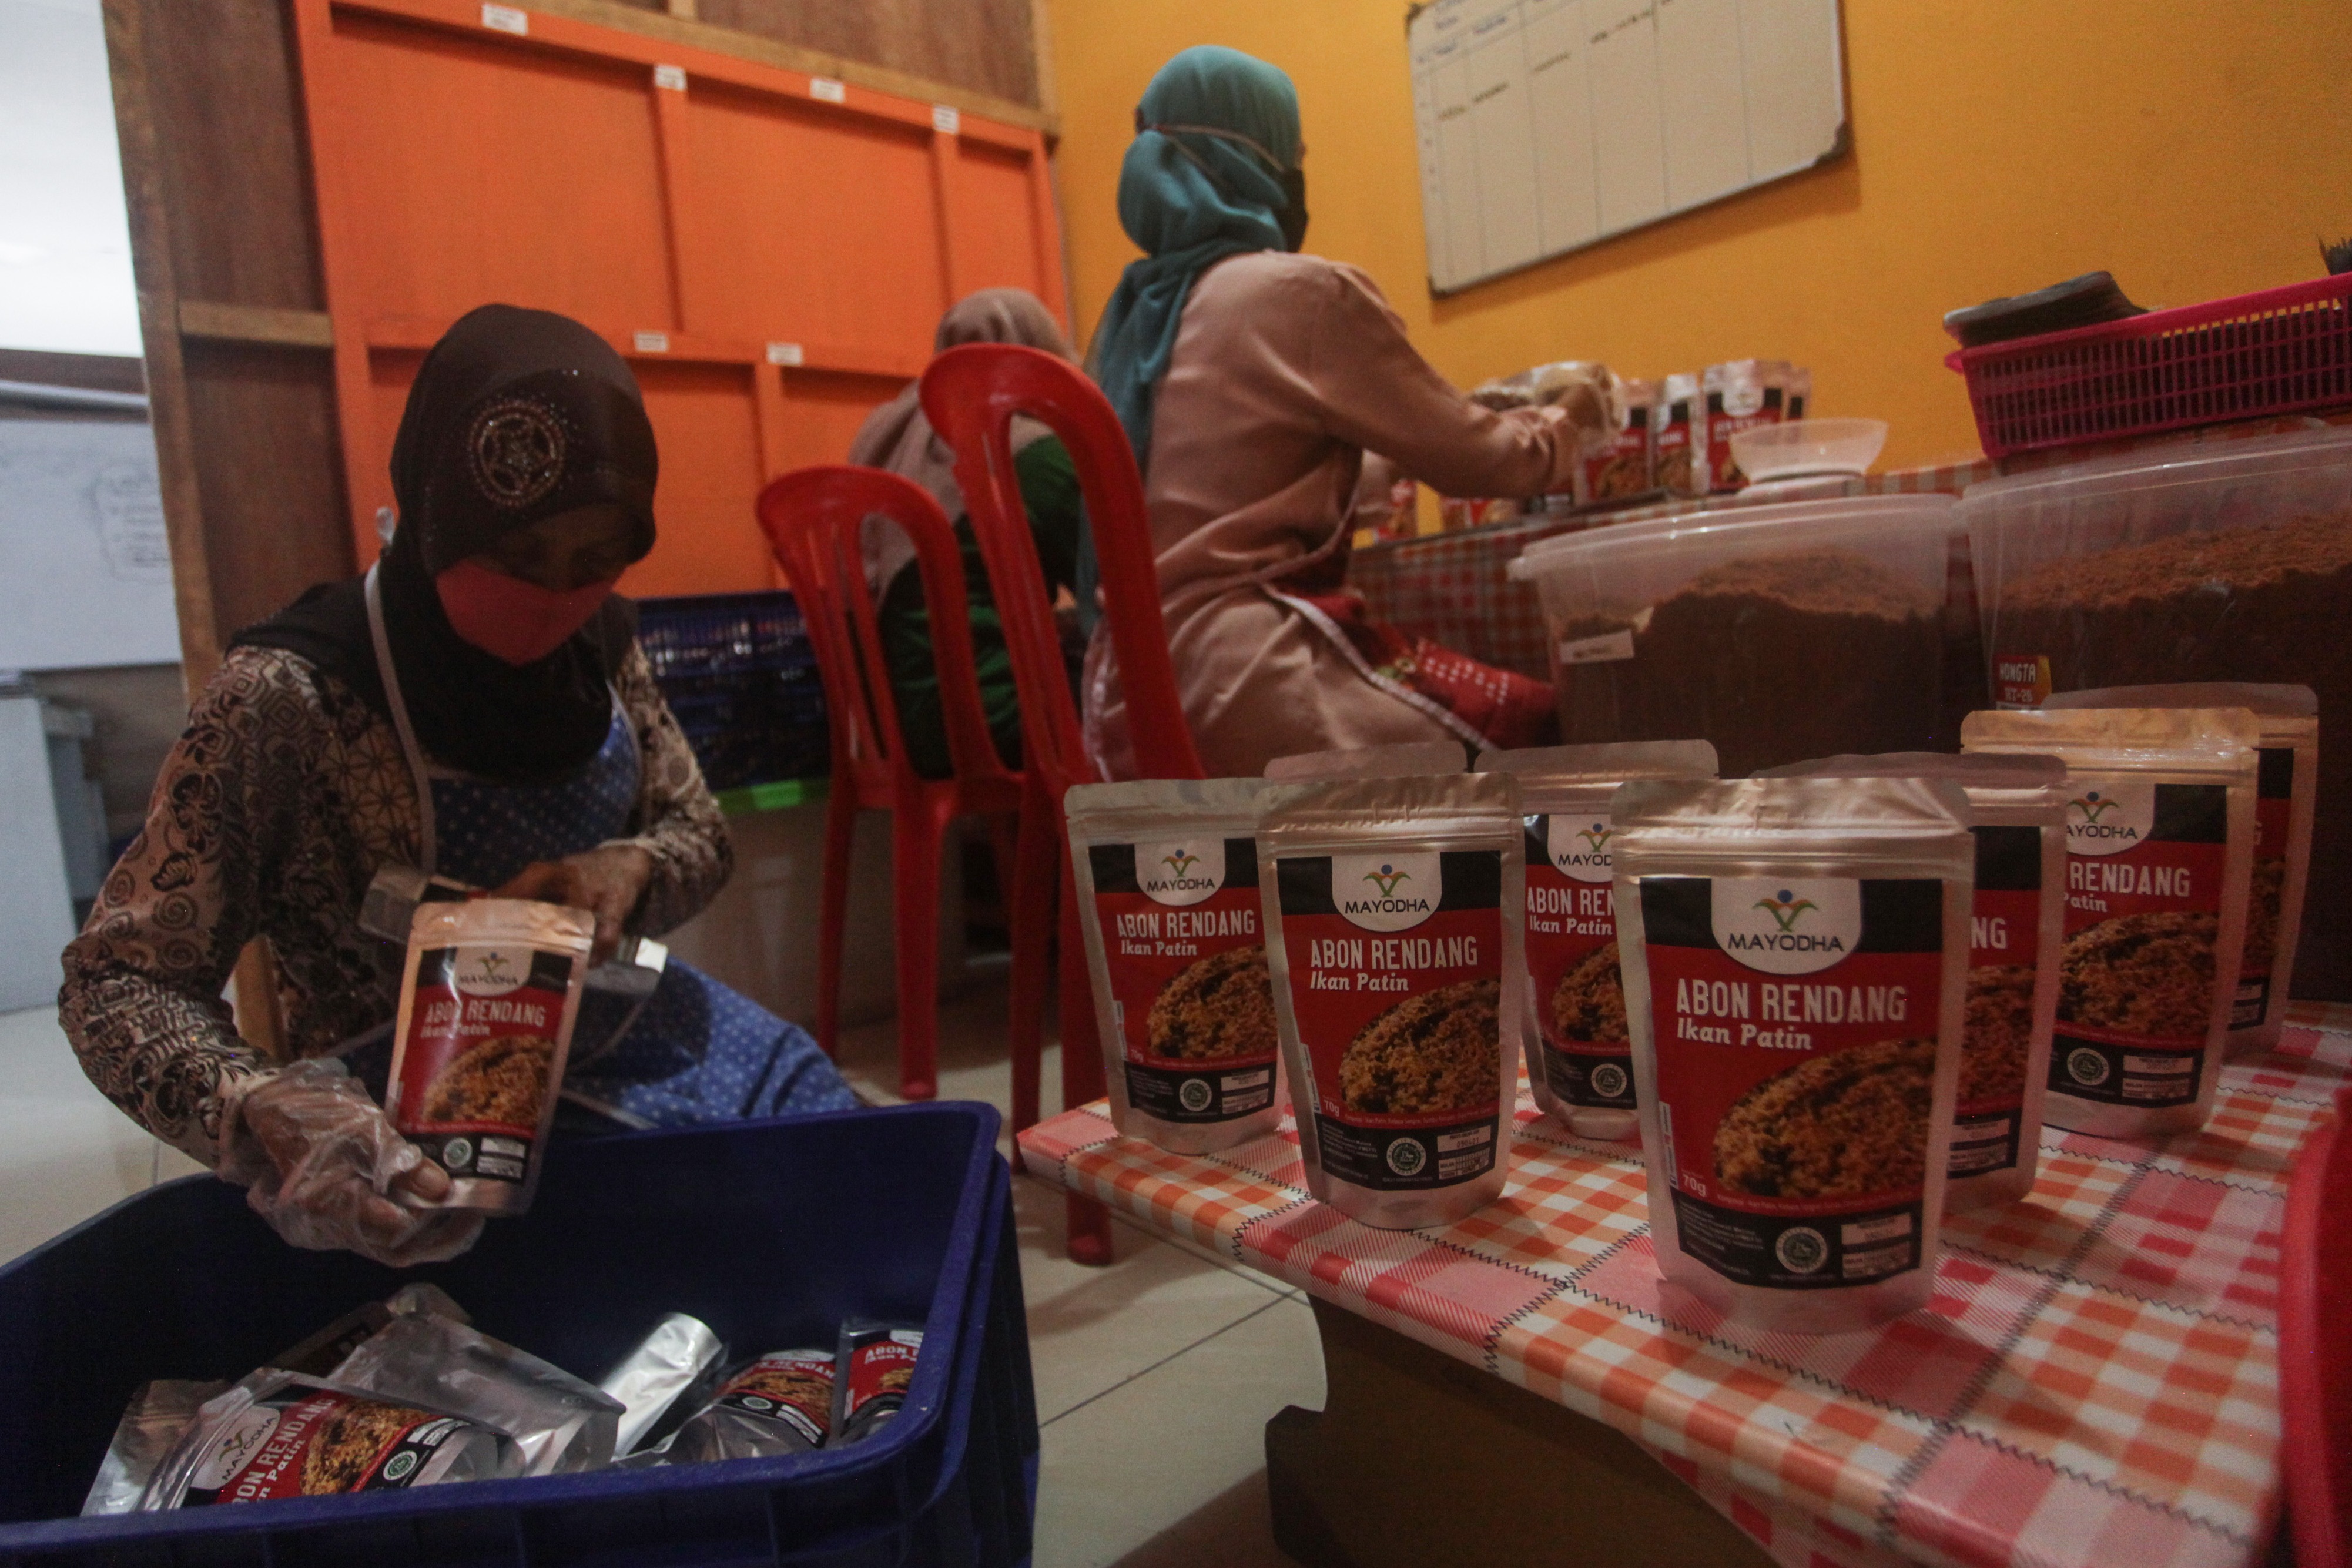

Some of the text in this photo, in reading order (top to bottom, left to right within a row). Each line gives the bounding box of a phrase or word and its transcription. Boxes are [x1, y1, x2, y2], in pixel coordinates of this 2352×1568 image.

[1147, 878, 1215, 892] MAYODHA
[2069, 861, 2190, 897] RENDANG
[1345, 899, 1430, 914] MAYODHA
[1527, 887, 1572, 915] ABON
[1117, 909, 1255, 939] ABON RENDANG
[1530, 914, 1613, 936] Ikan Patin
[1121, 940, 1198, 956] Ikan Patin
[1310, 936, 1479, 970] ABON RENDANG
[1727, 933, 1845, 952] MAYODHA
[1310, 970, 1409, 992] Ikan Patin
[466, 999, 547, 1027] RENDANG
[1676, 977, 1906, 1024] ABON RENDANG
[1677, 1017, 1814, 1050] Ikan Patin
[1324, 1099, 1340, 1117] 70g
[1682, 1173, 1706, 1198] 70g
[256, 1399, 337, 1466] RENDANG
[222, 1416, 277, 1482] MAYODHA
[266, 1440, 306, 1482] Patin
[232, 1470, 266, 1504] ON
